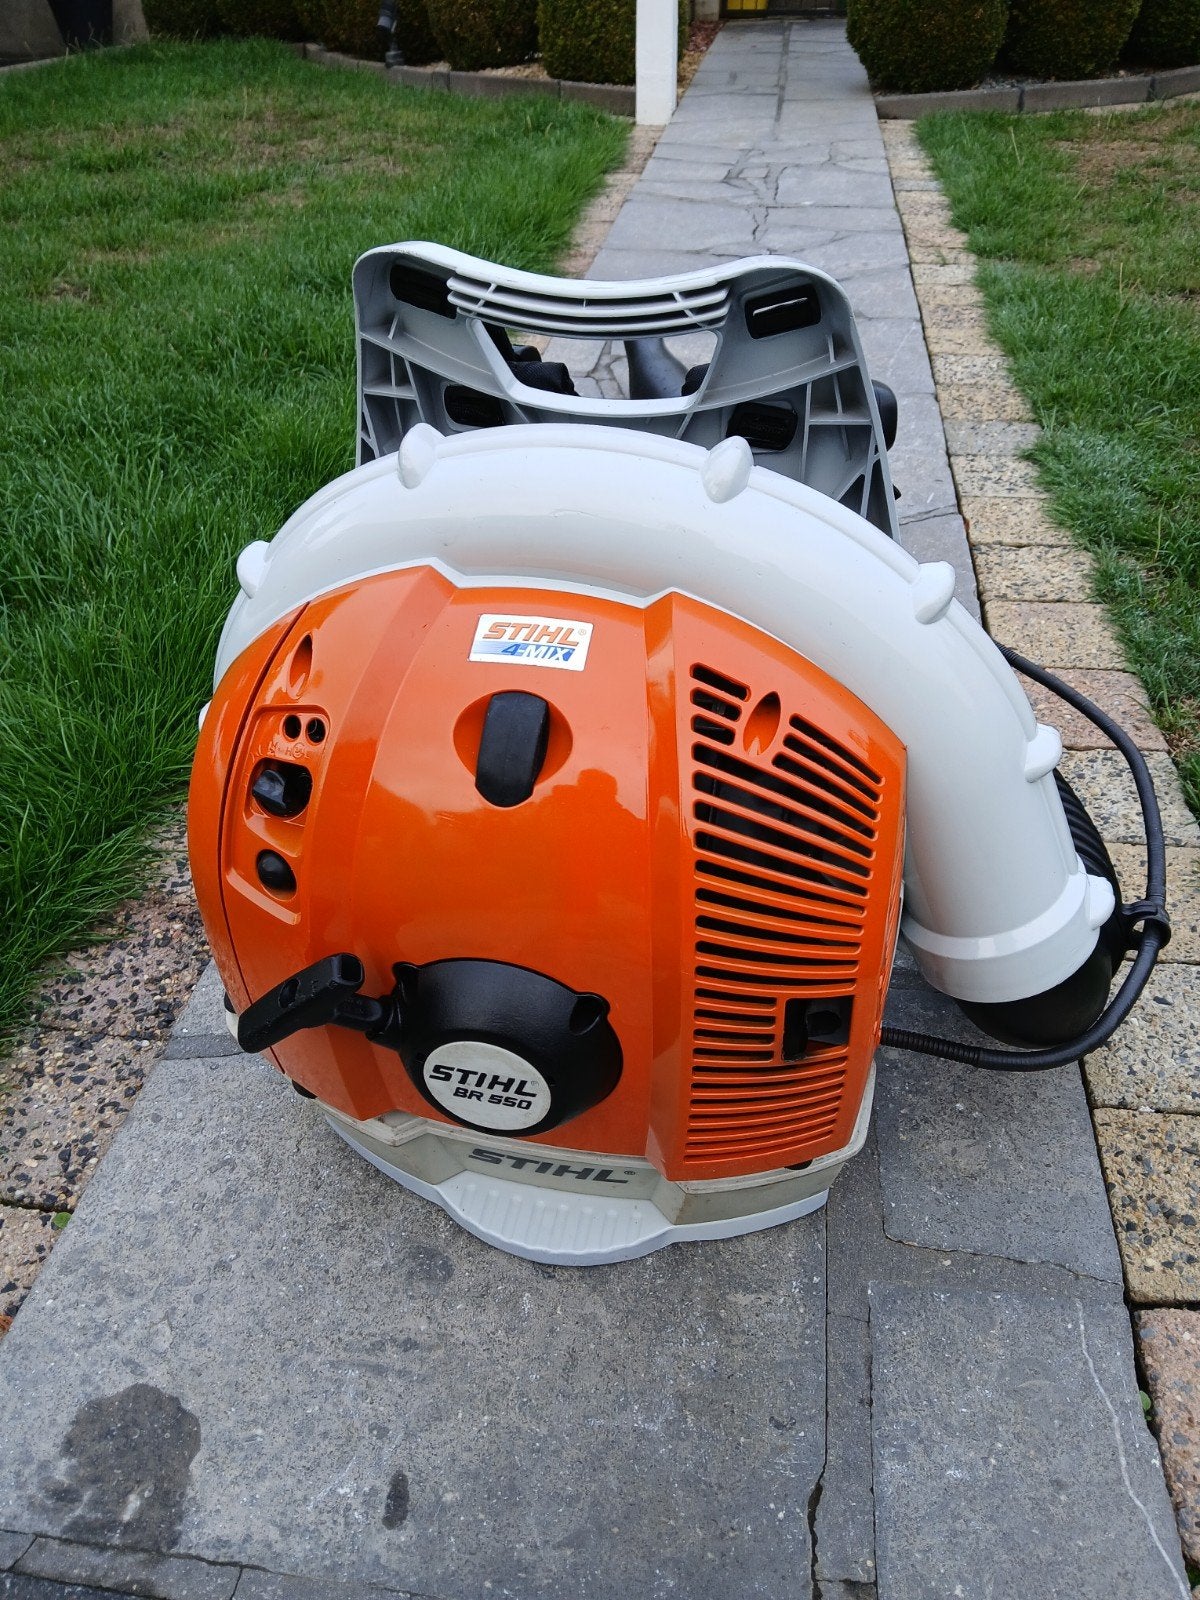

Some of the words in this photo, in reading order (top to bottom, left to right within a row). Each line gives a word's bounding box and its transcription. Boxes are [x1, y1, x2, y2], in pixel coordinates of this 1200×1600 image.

[482, 622, 580, 646] STIHL
[429, 1064, 537, 1098] STIHL
[453, 1086, 483, 1102] BR
[487, 1094, 533, 1111] 550
[468, 1148, 628, 1183] STIHL
